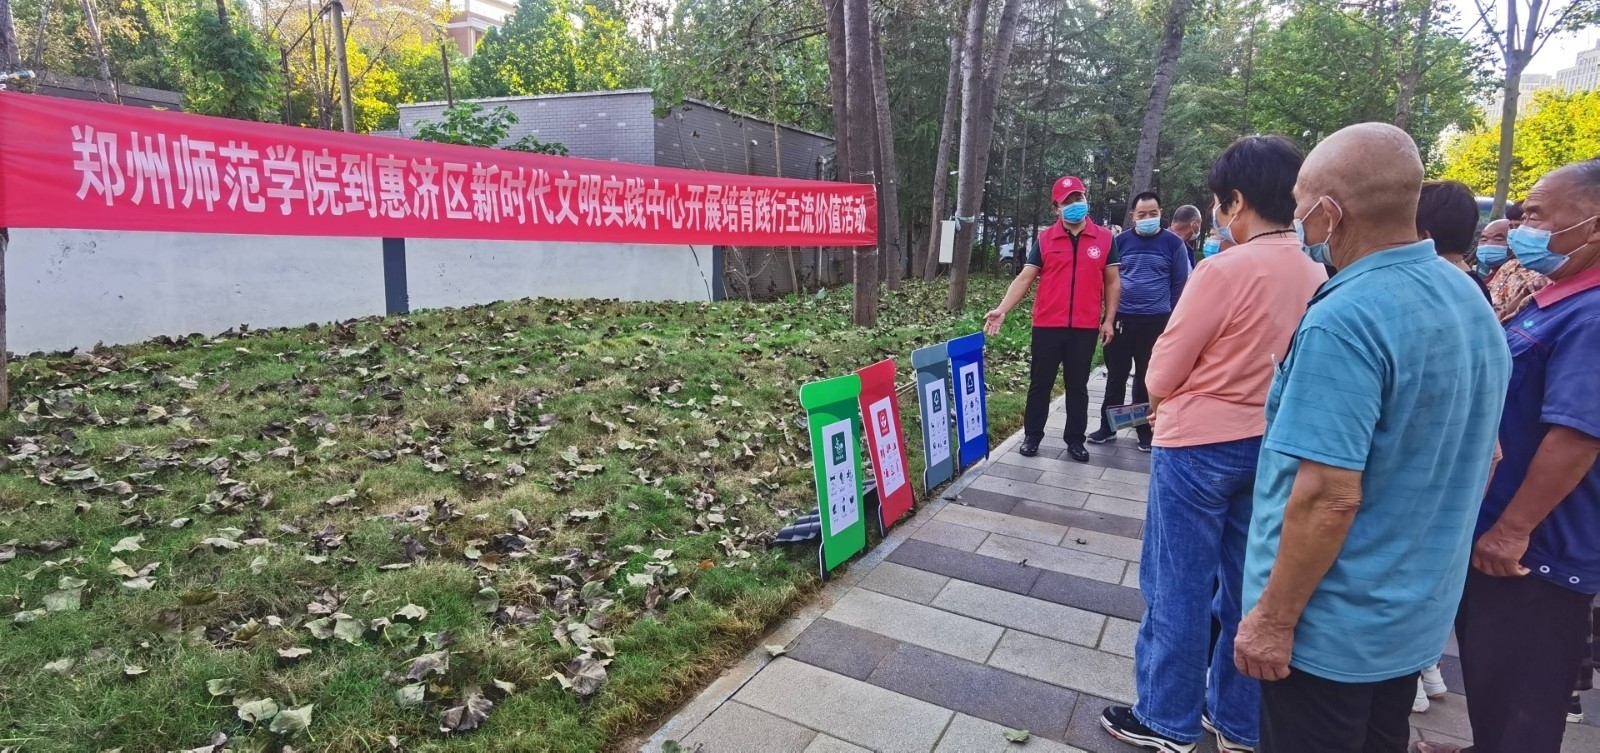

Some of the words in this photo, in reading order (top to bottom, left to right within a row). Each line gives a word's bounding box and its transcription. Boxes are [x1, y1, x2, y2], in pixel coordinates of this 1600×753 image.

[71, 124, 866, 234] 郑州师范学院到惠济区新时代文明实践中心开展培育践行主流价值活动
